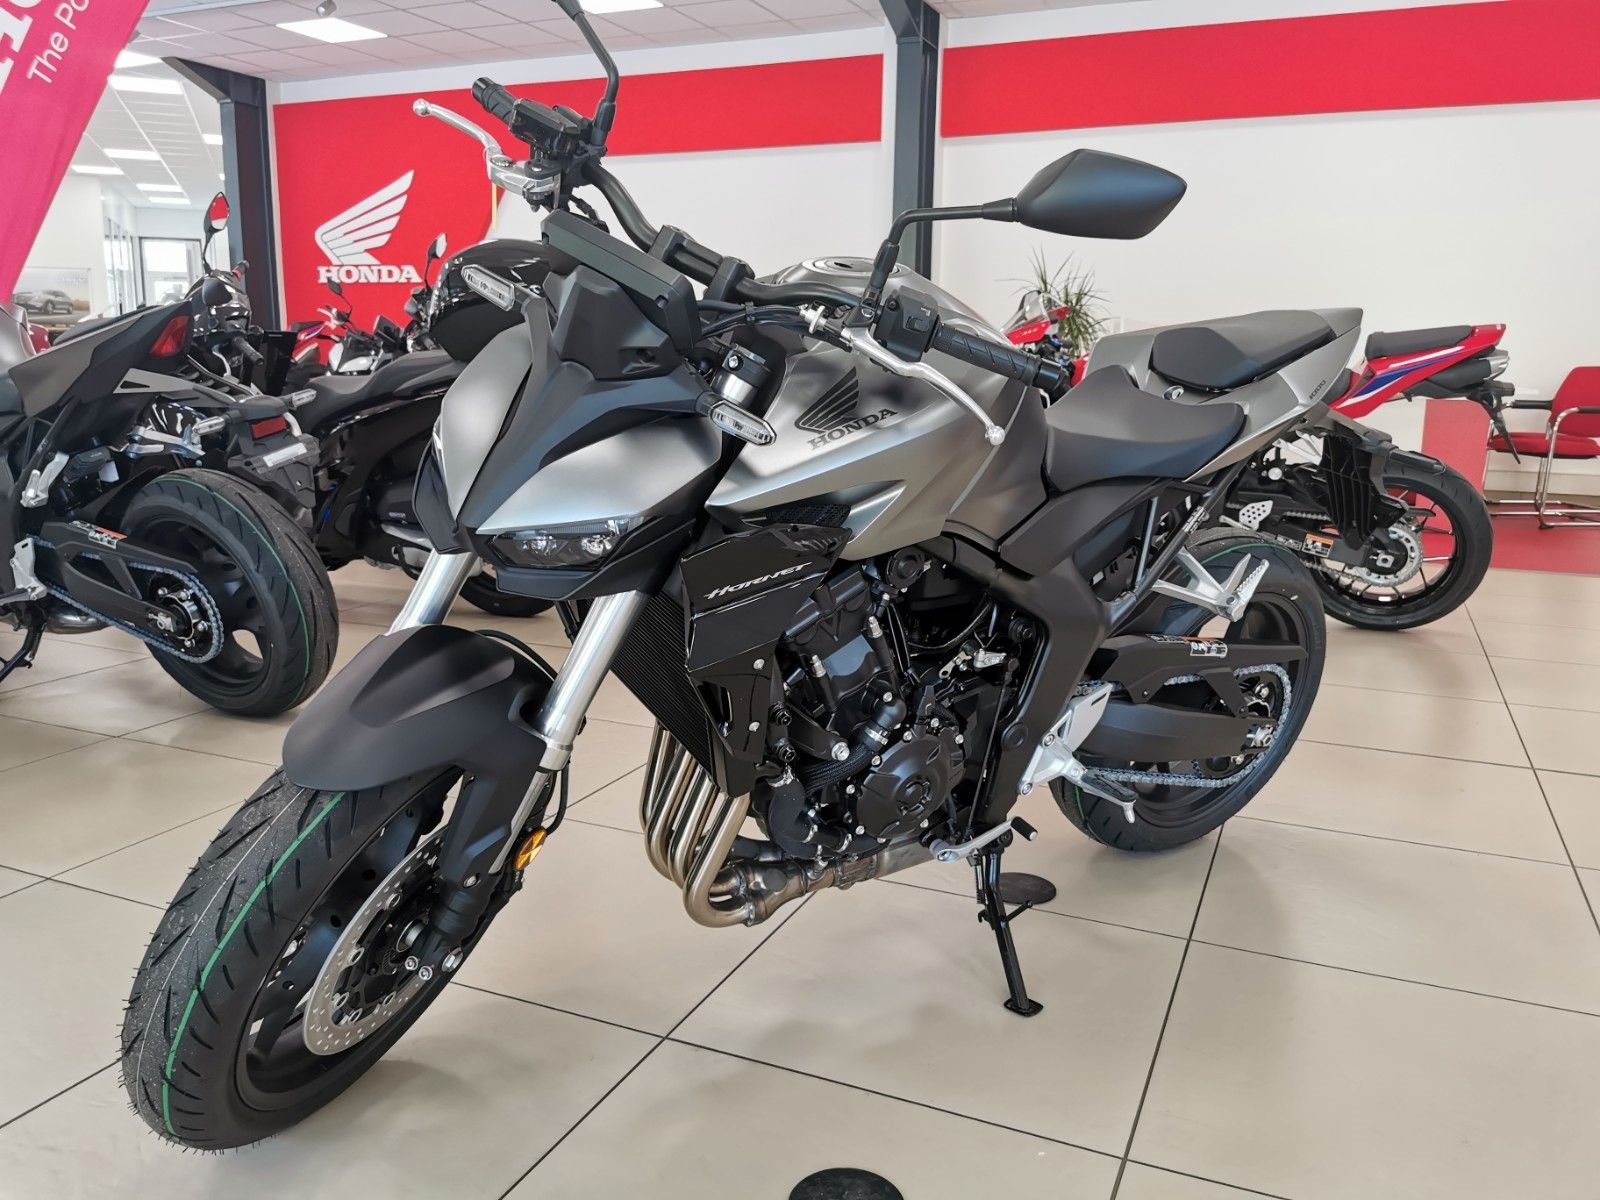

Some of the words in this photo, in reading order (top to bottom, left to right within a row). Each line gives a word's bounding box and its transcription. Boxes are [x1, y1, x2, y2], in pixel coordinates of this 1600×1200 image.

[27, 32, 69, 84] The
[317, 264, 423, 284] HONDA
[807, 408, 898, 450] HONDA
